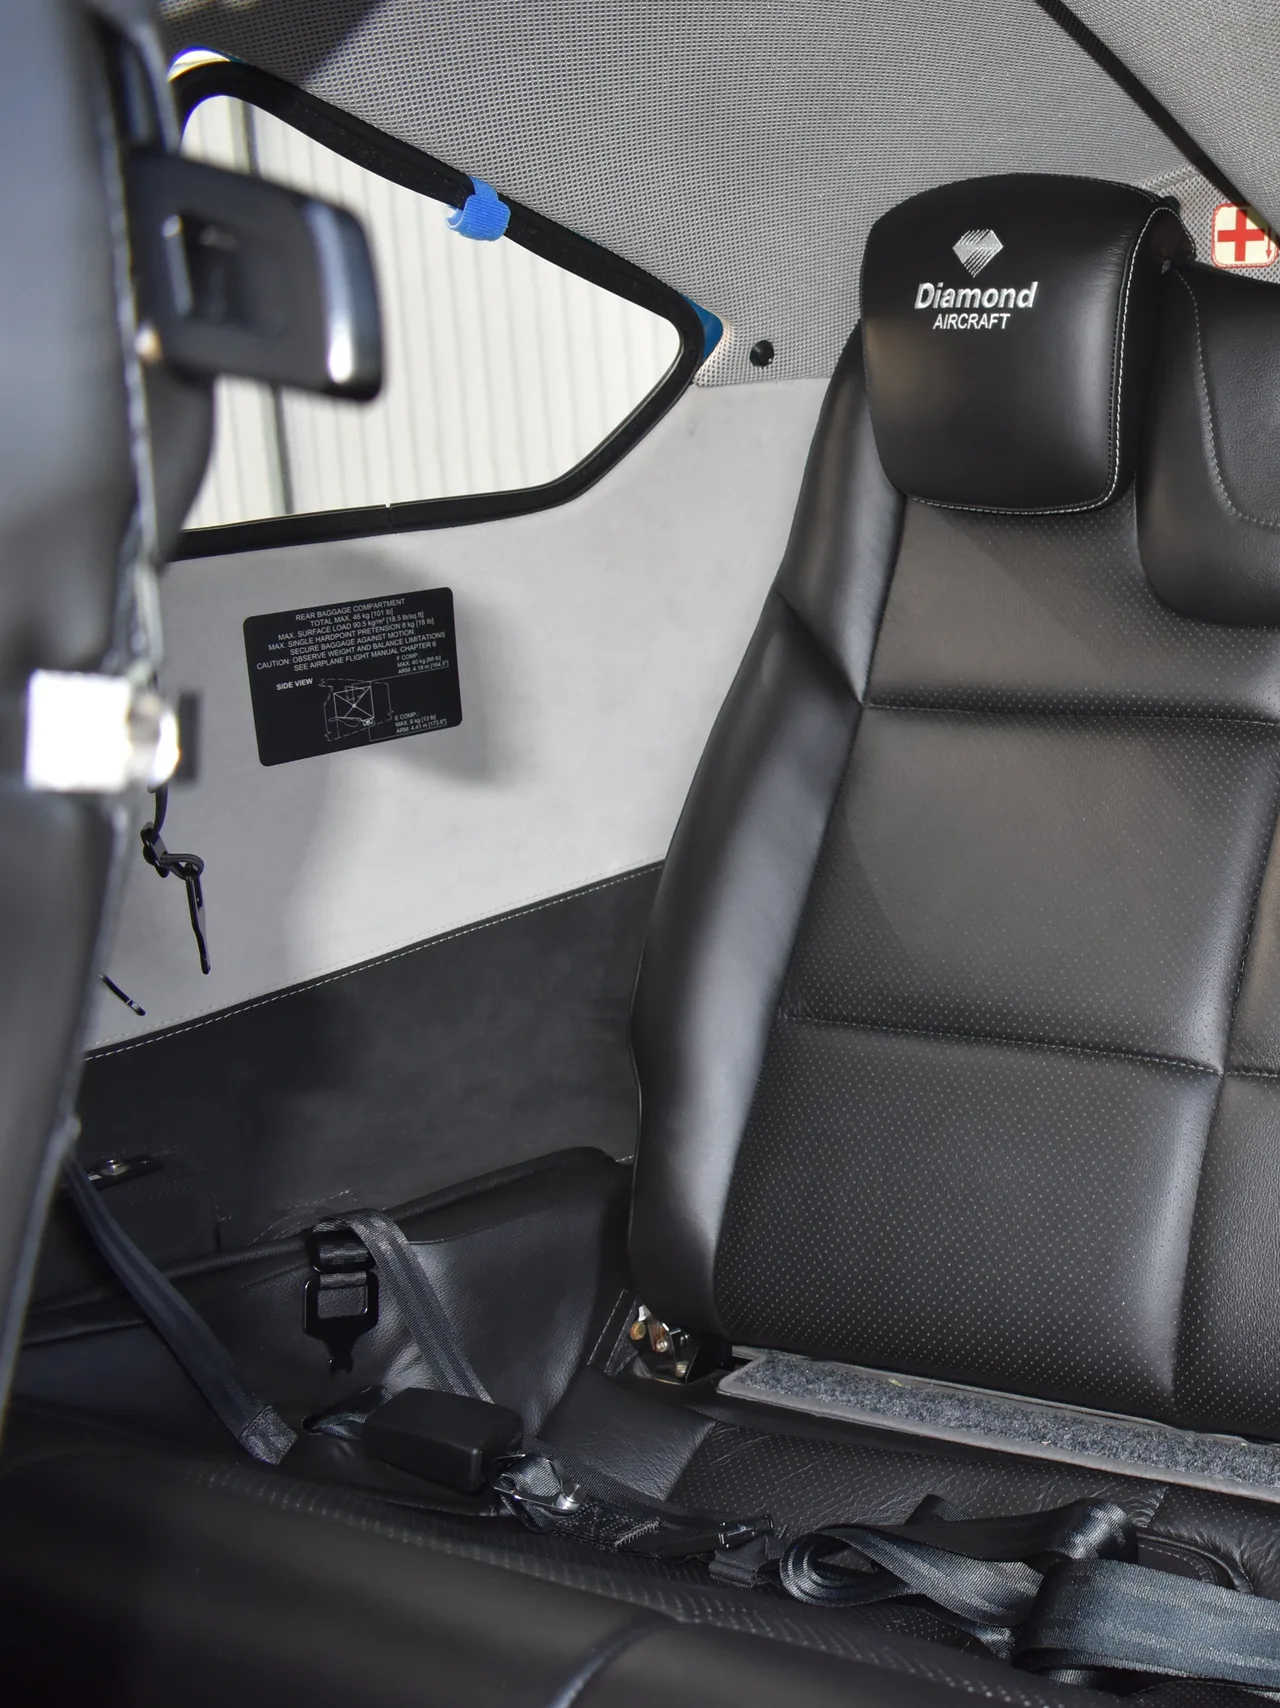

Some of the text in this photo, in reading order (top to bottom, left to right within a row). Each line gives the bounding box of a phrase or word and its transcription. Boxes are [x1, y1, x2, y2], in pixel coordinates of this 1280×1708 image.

[914, 281, 1038, 309] Diamond
[932, 313, 1011, 329] AIRCRAFT
[296, 598, 405, 620] REAR BAGGAGE COMPARTMENT
[371, 610, 384, 619] [101
[288, 638, 314, 647] SINGLE
[315, 630, 355, 643] HARDPOINT
[358, 624, 400, 636] PRETENSION
[298, 626, 331, 638] SURFACE
[332, 623, 351, 631] LOAD
[386, 615, 402, 624] [18.5
[256, 632, 445, 670] CAUTION: OBSERVE WEIGHT AND BALANCE LIMITATIONS
[290, 645, 319, 655] SECURE
[321, 639, 355, 650] BAGGAGE
[357, 633, 386, 644] AGAINST
[310, 657, 344, 668] AIRPLANE
[346, 652, 369, 662] FLIGHT
[371, 648, 398, 658] MANUAL
[400, 642, 431, 652] CHAPTER
[276, 678, 313, 690] SIDE VIEW
